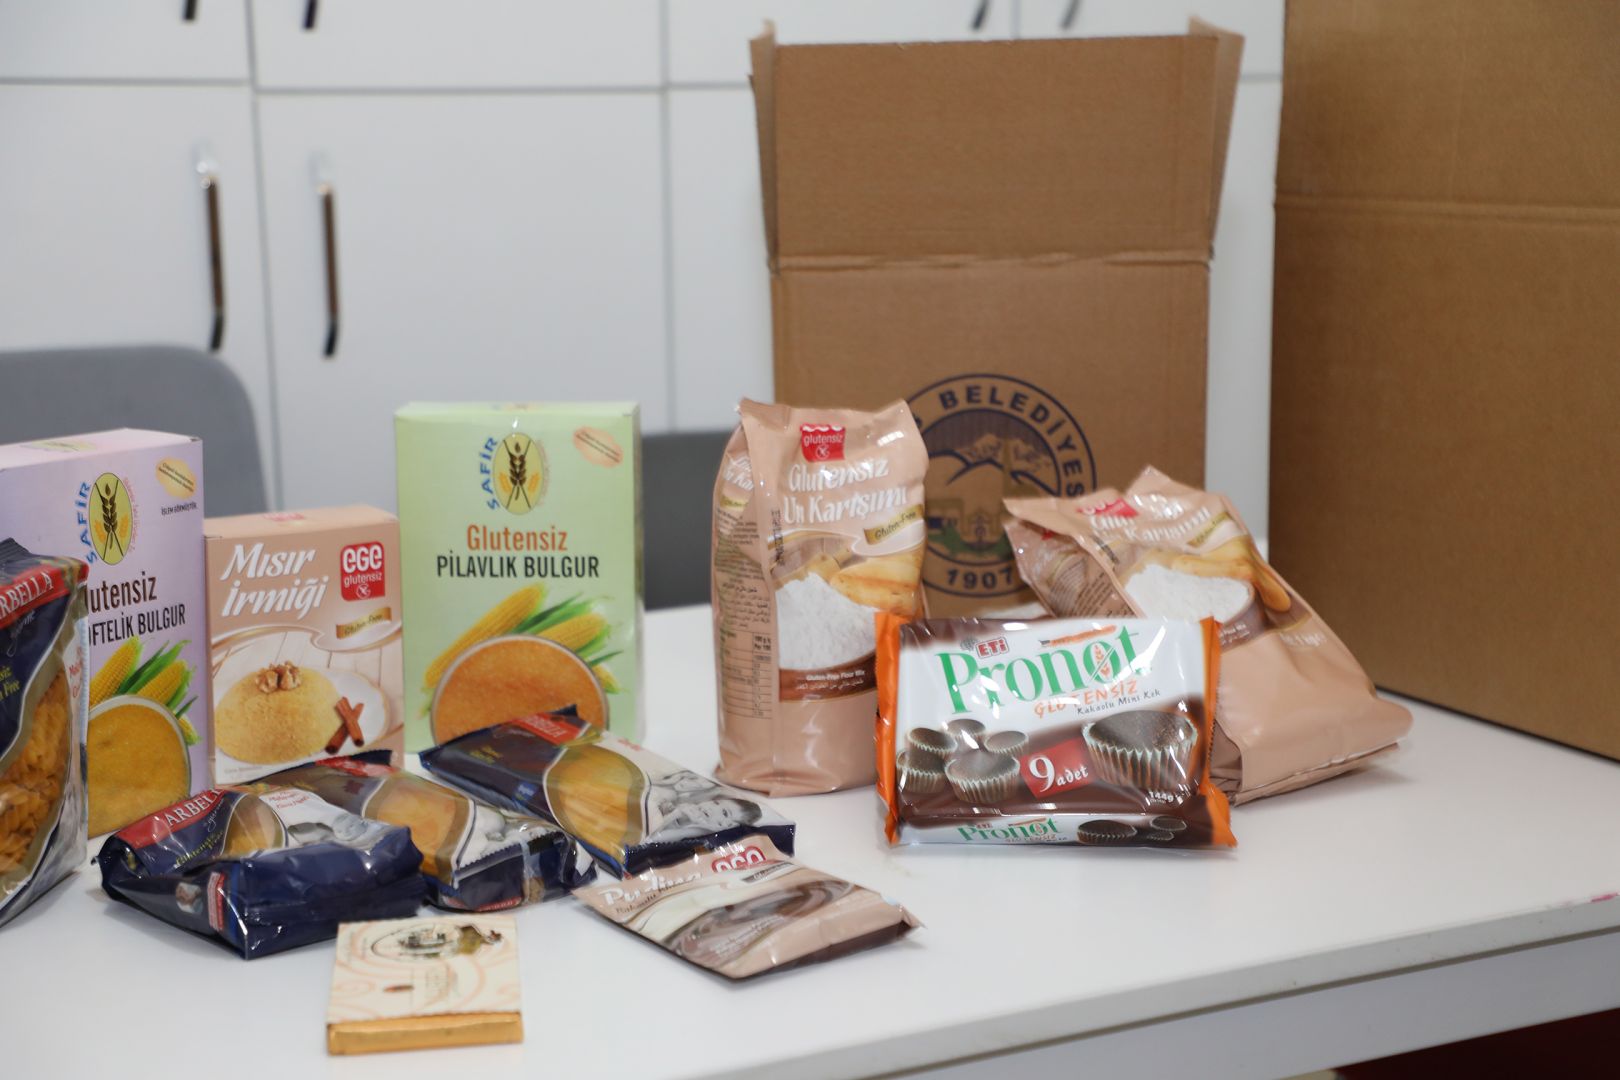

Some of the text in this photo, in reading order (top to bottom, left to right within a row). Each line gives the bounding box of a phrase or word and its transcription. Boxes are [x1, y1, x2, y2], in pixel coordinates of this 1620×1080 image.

[788, 456, 889, 493] Glutensiz
[466, 524, 569, 552] Glutensiz
[219, 541, 317, 582] Mısır
[343, 571, 383, 588] glutensiz
[436, 549, 600, 579] PİLAVLIK BULGUR
[946, 566, 1014, 590] 1907
[0, 570, 54, 620] RBELLA
[85, 570, 158, 615] lutensiz
[88, 603, 187, 647] FTELİK BULGUR
[935, 624, 1152, 718] Pronot
[1076, 702, 1115, 715] Kakaolu
[1028, 755, 1090, 792] 9 adet
[164, 788, 225, 826] ARBELL
[957, 818, 1061, 842] Pronot
